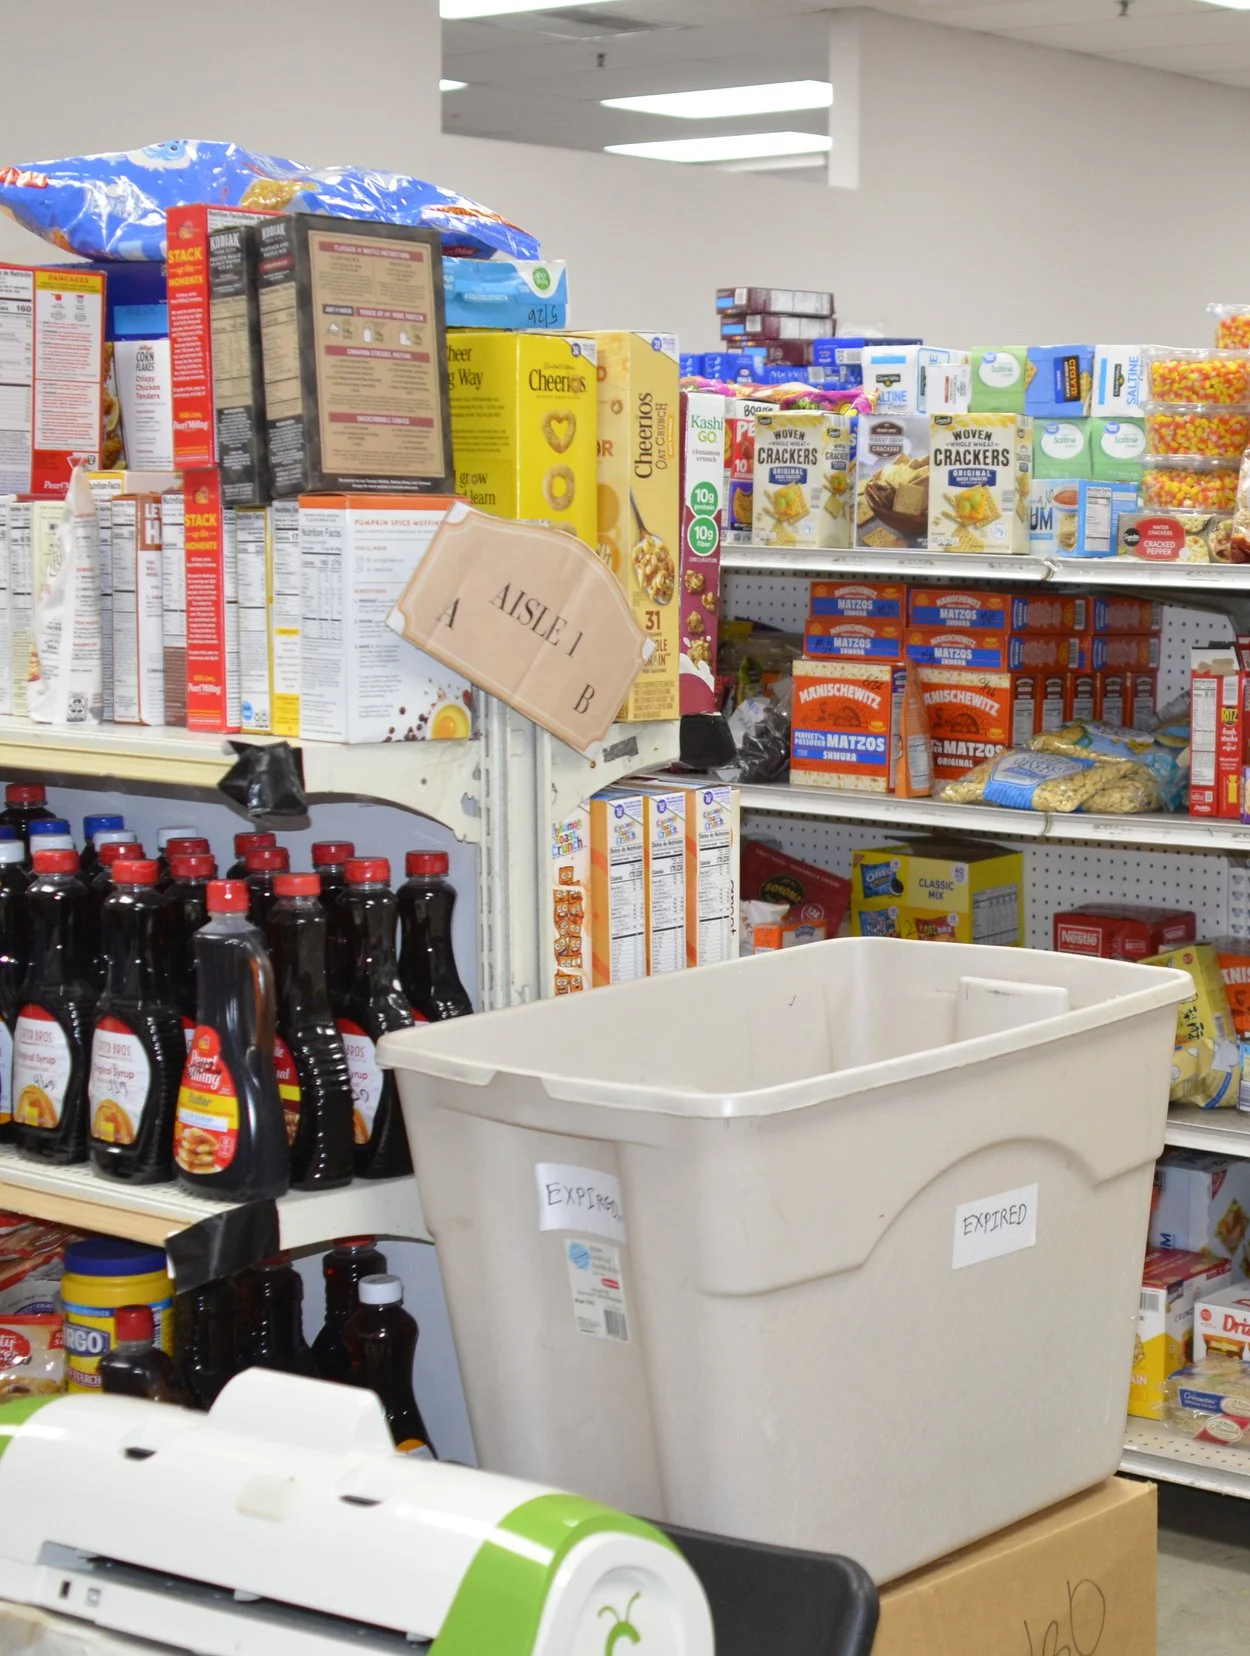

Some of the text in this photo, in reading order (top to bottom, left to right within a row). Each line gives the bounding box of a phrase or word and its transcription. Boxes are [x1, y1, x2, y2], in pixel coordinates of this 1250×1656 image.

[261, 222, 286, 237] KODIAK
[210, 232, 240, 249] KODIAK
[168, 247, 203, 262] STACK
[168, 276, 203, 287] MOMENTS
[136, 351, 155, 371] CORN FLAKES
[136, 376, 154, 384] Crispy
[459, 370, 483, 390] Way
[529, 370, 586, 393] Cheerios
[1127, 355, 1139, 405] SALTINE
[690, 414, 724, 432] Kashi
[634, 392, 653, 479] Cheerios
[655, 403, 667, 470] OAT CRUNCH
[773, 429, 805, 440] WOVEN
[952, 429, 992, 441] WOVEN
[757, 448, 817, 465] CRACKERS
[934, 448, 1010, 467] CRACKERS
[694, 489, 715, 503] 10g
[184, 514, 217, 526] STACK
[694, 526, 713, 539] 10g
[185, 541, 217, 551] MOMENTS
[834, 585, 877, 598] MANISCHEWITZ
[838, 600, 873, 610] MATZOS
[936, 595, 981, 608] MANISCHEWITZ
[437, 597, 460, 630] A
[489, 582, 584, 659] AISLE 1
[645, 611, 660, 630] 31
[939, 609, 977, 620] MATZOS
[830, 624, 876, 637] MANISCHEWITZ
[834, 637, 871, 648] MATZOS
[930, 634, 977, 648] MANISCHEWITZ
[934, 648, 972, 659] MATZOS
[572, 684, 595, 715] B
[798, 683, 881, 709] MANISCHEWITZ
[924, 689, 1000, 716] ANISCHEWITZ
[1221, 708, 1238, 722] RITZ
[794, 731, 819, 739] PERFECT
[794, 738, 826, 748] PASSOVER
[826, 734, 885, 752] MATZOS
[943, 741, 1004, 758] MATZOS
[822, 750, 857, 762] SHMURA
[936, 756, 974, 768] ORIGINAL
[918, 878, 954, 892] CLASSIC
[927, 890, 944, 900] MIX
[36, 1054, 56, 1065] Syrup
[191, 1050, 217, 1065] Pearl
[113, 1068, 135, 1080] Syrup
[963, 1203, 1028, 1236] EXPIRED
[67, 1328, 103, 1353] RGO
[73, 1371, 101, 1384] STARCH
